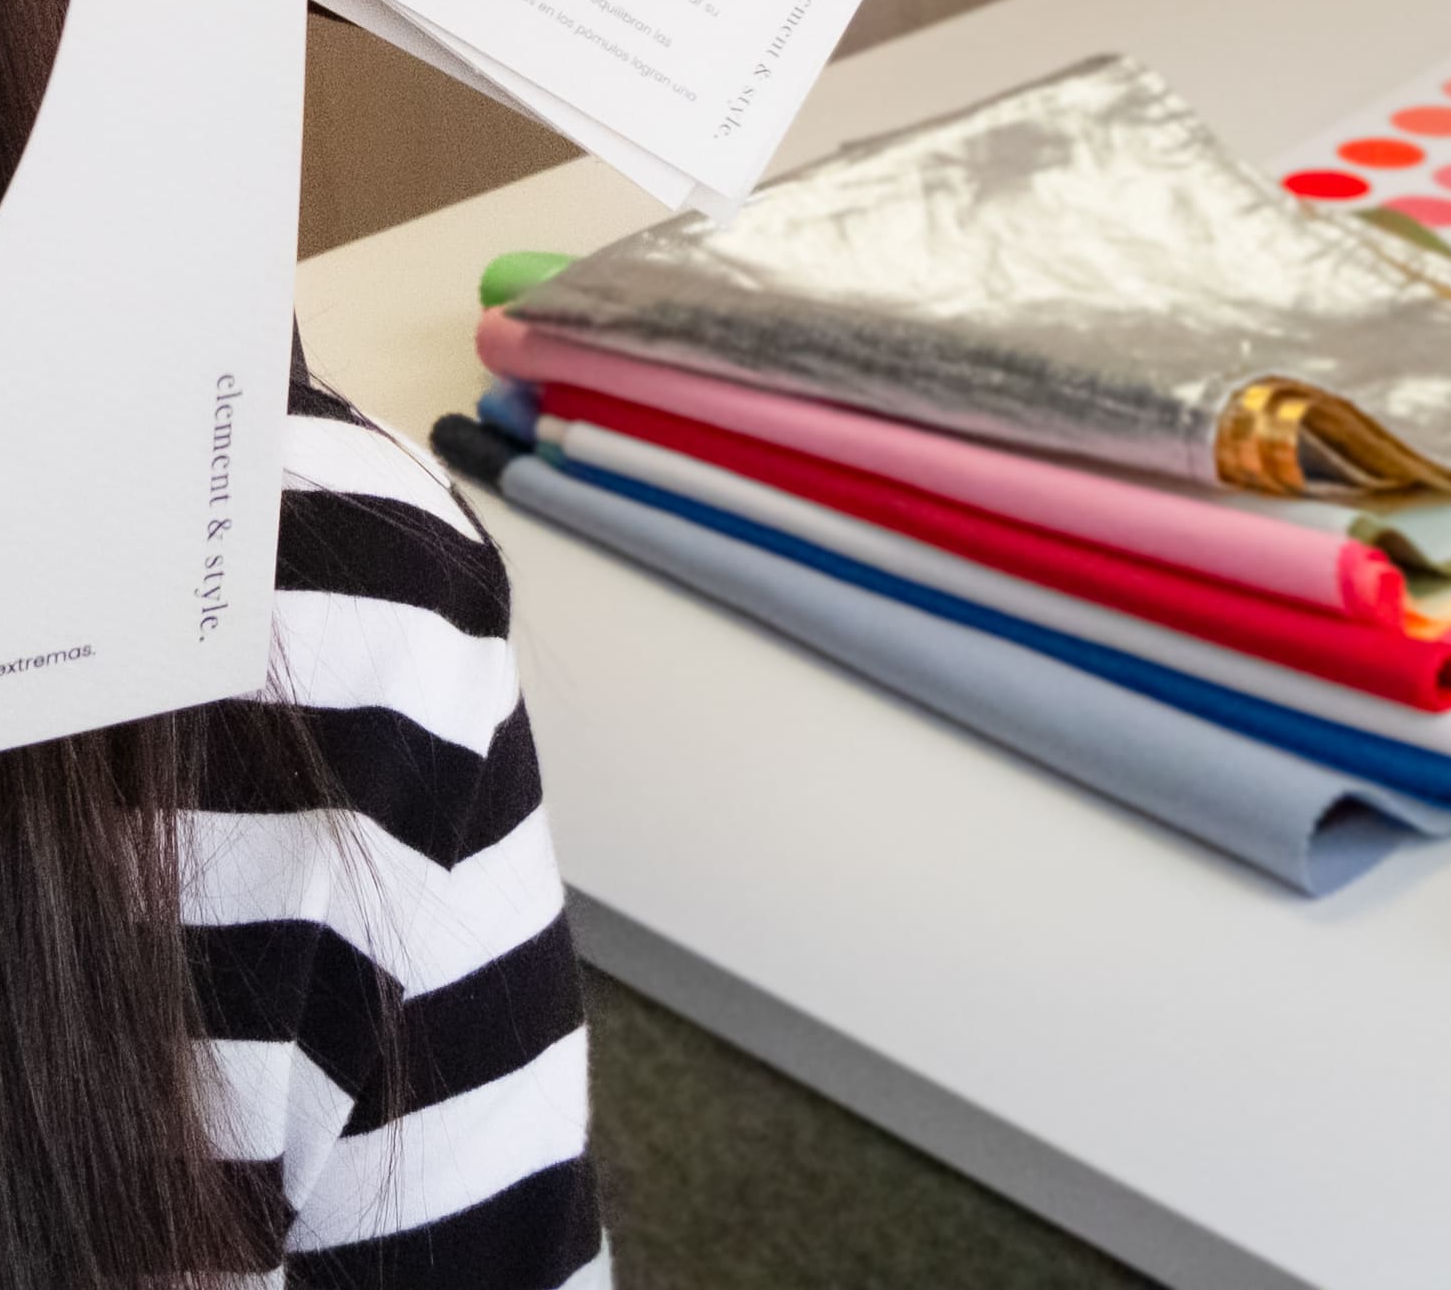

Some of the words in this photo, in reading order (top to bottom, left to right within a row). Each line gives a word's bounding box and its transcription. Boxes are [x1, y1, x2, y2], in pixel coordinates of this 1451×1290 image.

[753, 63, 771, 79] &
[209, 373, 244, 508] element
[207, 518, 232, 541] &
[194, 554, 229, 643] style.
